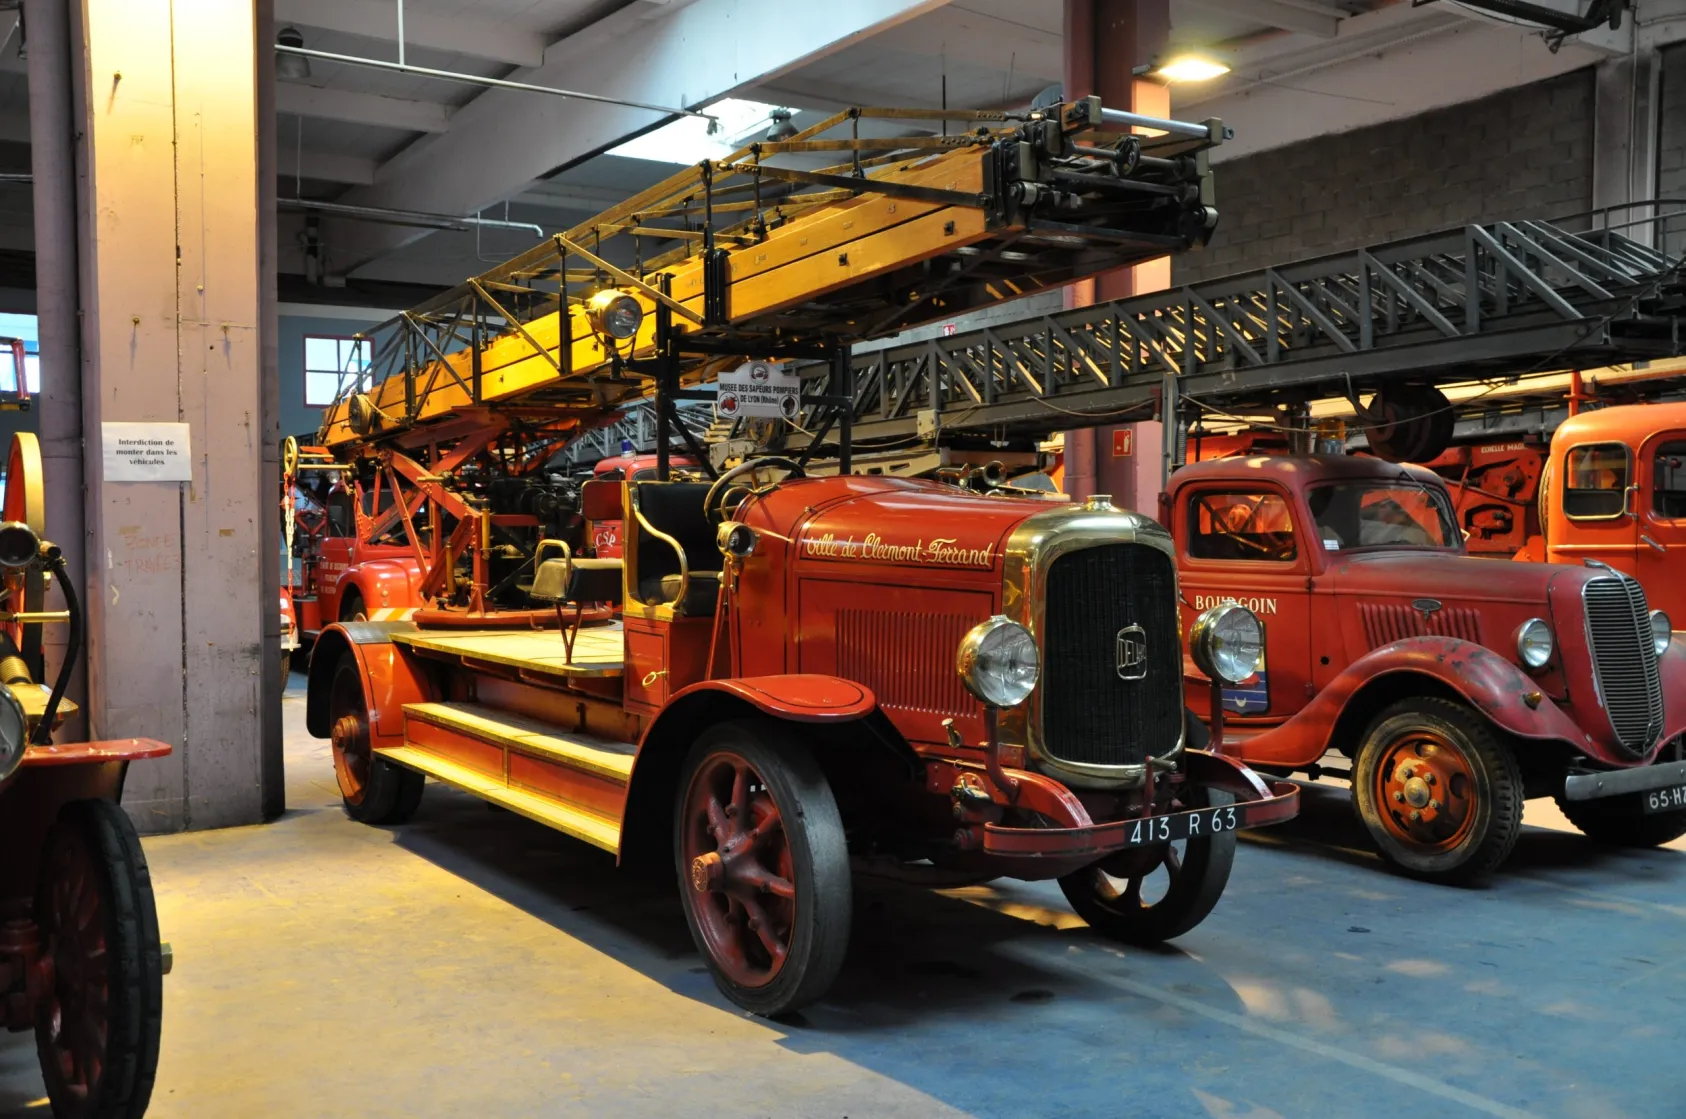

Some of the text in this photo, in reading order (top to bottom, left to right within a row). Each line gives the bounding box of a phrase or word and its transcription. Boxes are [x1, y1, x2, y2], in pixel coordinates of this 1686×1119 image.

[719, 383, 799, 395] MUSEE DES SAPEURS POMPIERS
[740, 394, 747, 403] DE
[748, 395, 760, 403] LYON
[118, 438, 163, 446] Interdiction
[840, 535, 857, 558] de
[1195, 595, 1278, 614] BOUGOIN
[1130, 807, 1237, 844] 413 R 63
